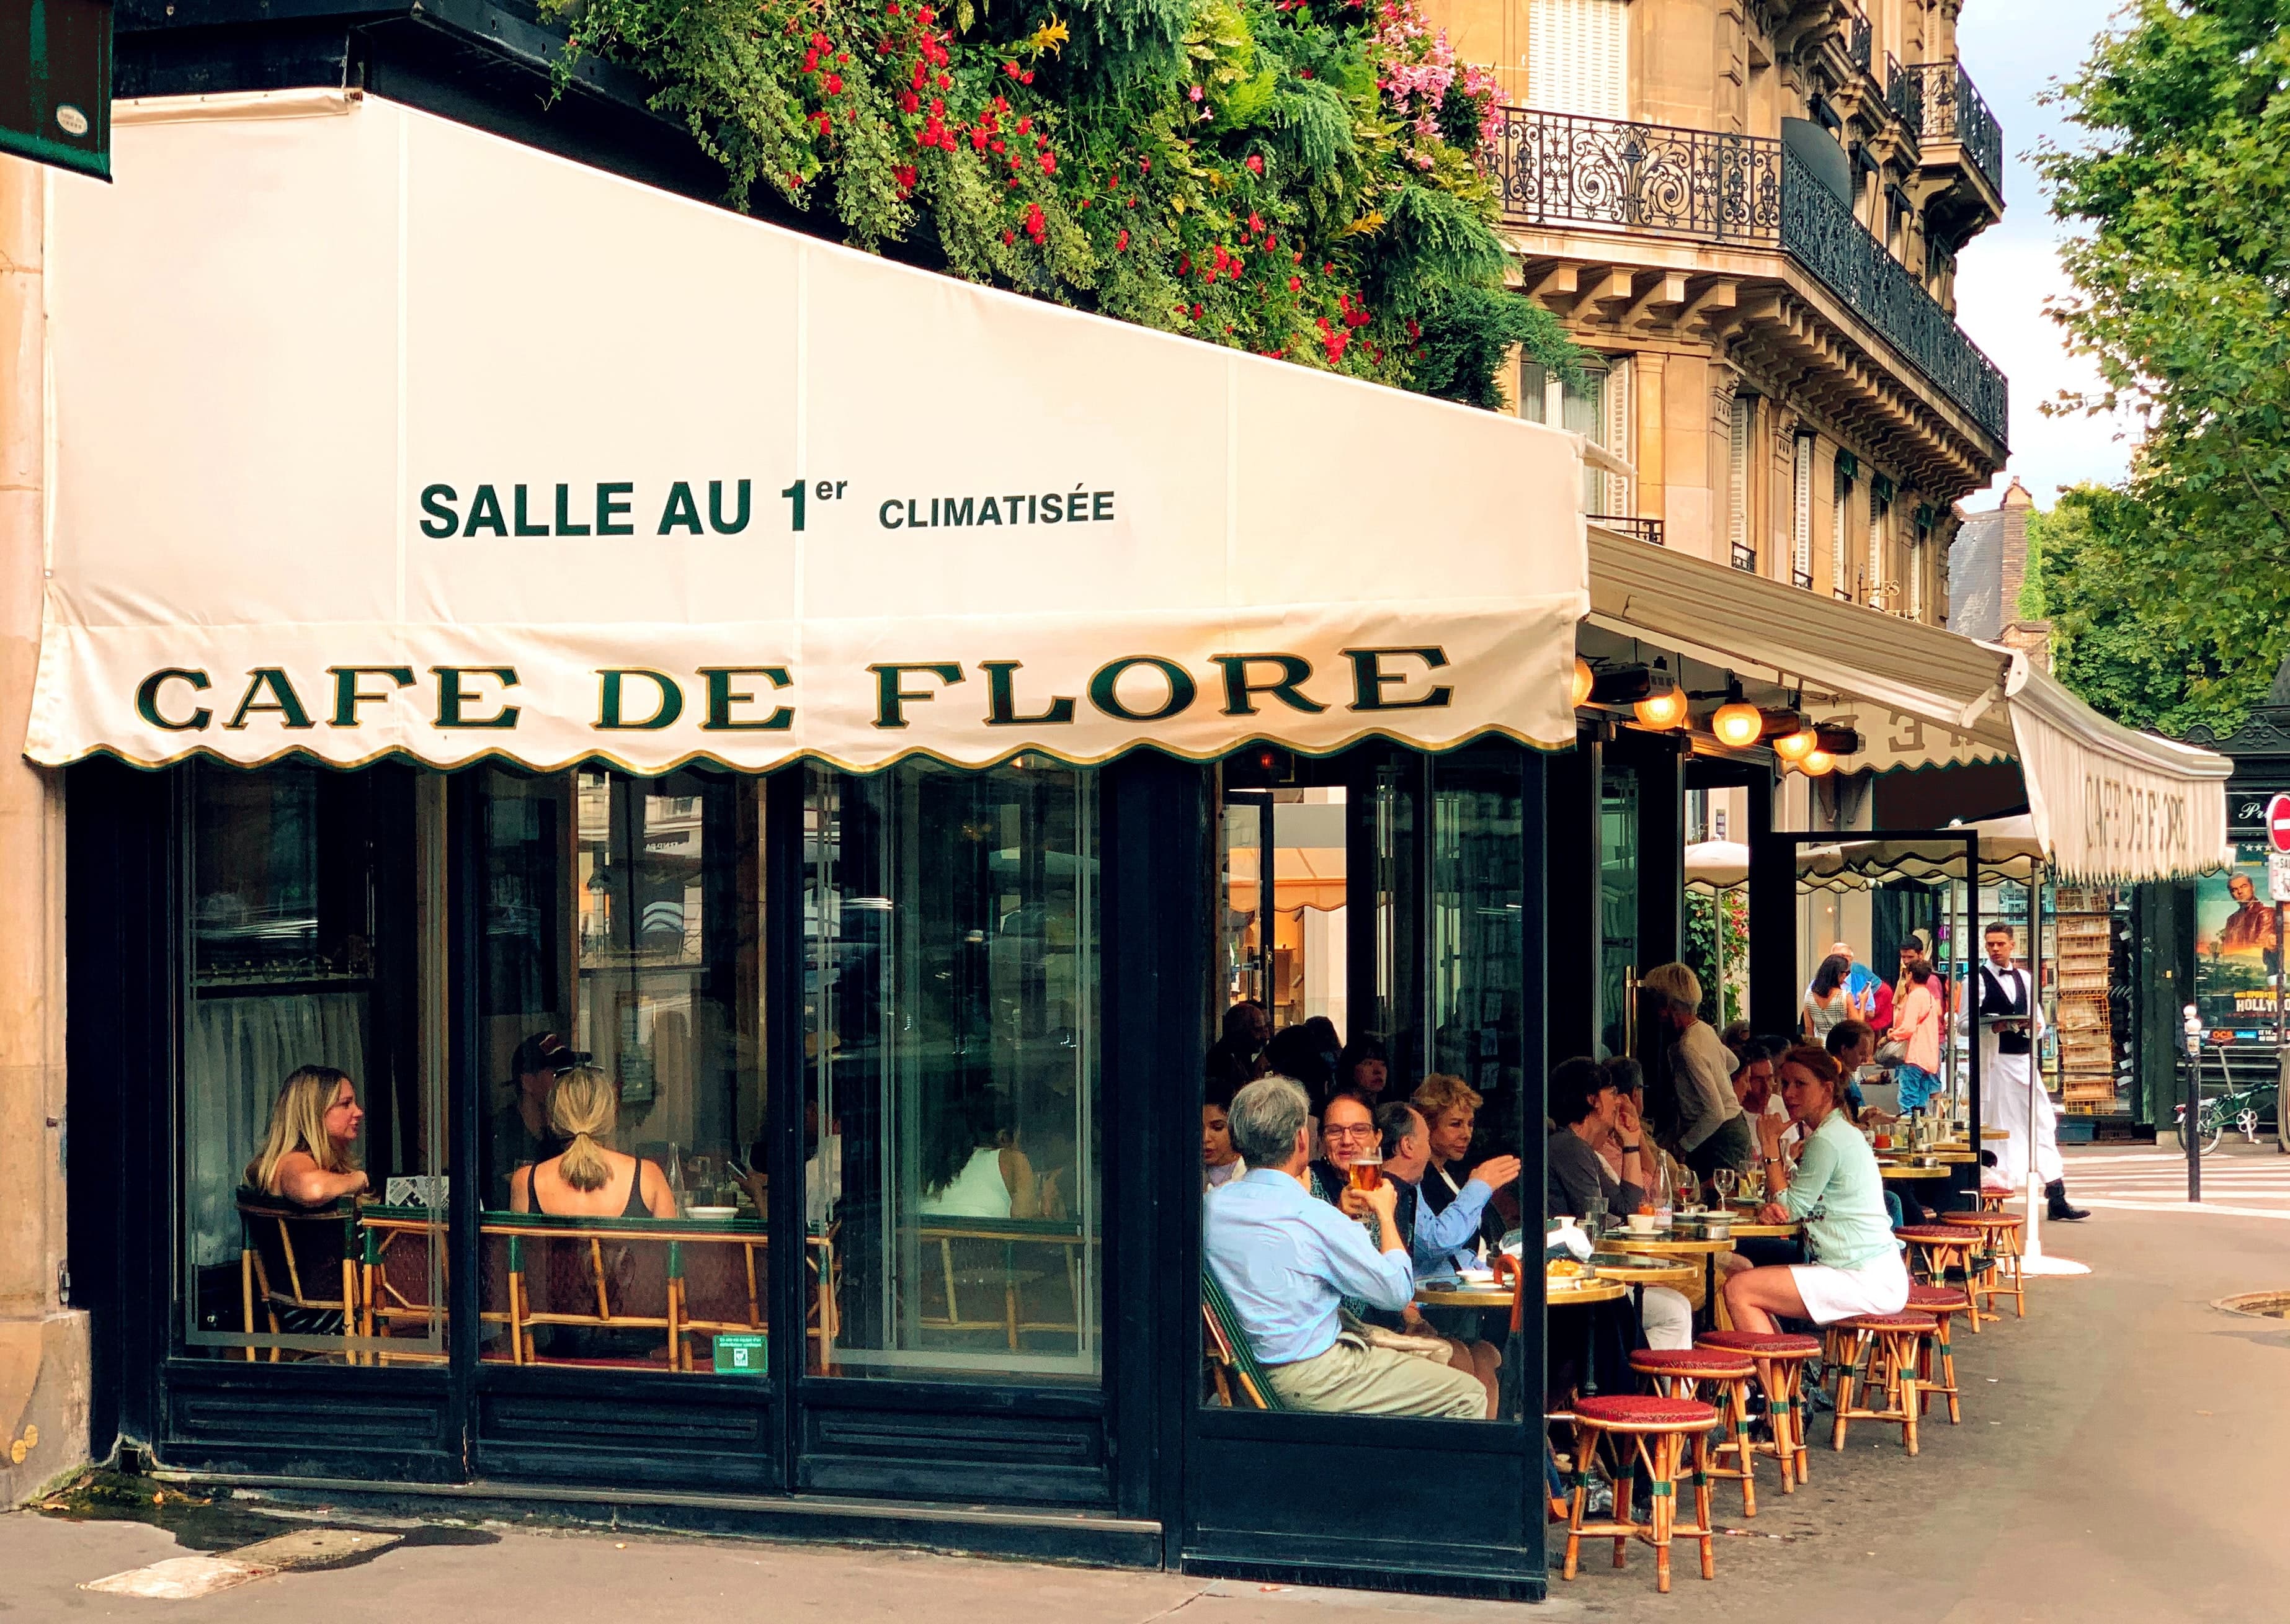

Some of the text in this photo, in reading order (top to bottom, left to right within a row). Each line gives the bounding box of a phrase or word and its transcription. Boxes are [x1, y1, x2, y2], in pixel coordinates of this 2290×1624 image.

[419, 478, 1115, 539] SALLE AU 1er CLIMATISÉE
[1868, 580, 1900, 597] LES
[134, 645, 1455, 733] CAFE DE FLORE
